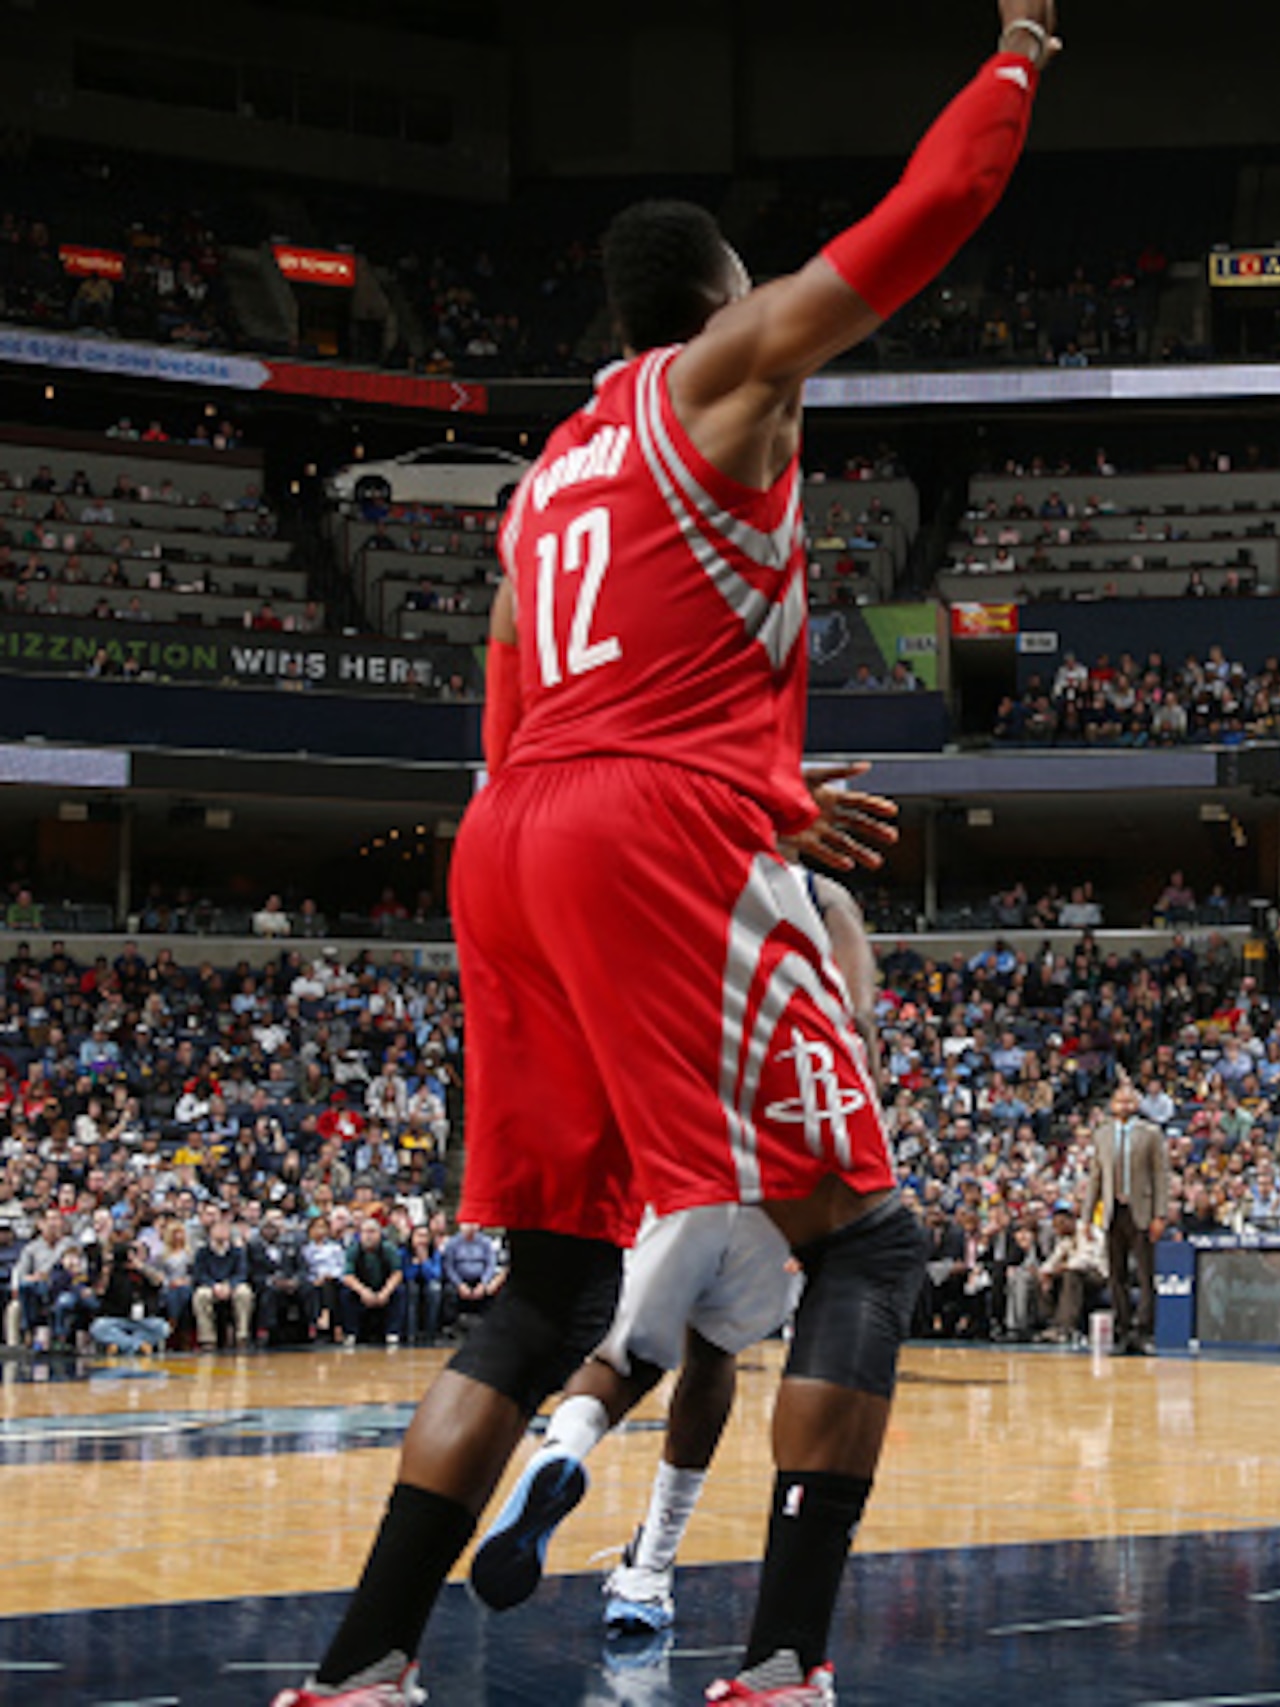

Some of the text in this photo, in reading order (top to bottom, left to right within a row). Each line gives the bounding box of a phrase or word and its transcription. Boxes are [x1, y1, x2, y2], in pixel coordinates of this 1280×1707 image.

[535, 506, 623, 687] 12
[0, 632, 219, 671] IZZNATION
[231, 646, 327, 680] WINS
